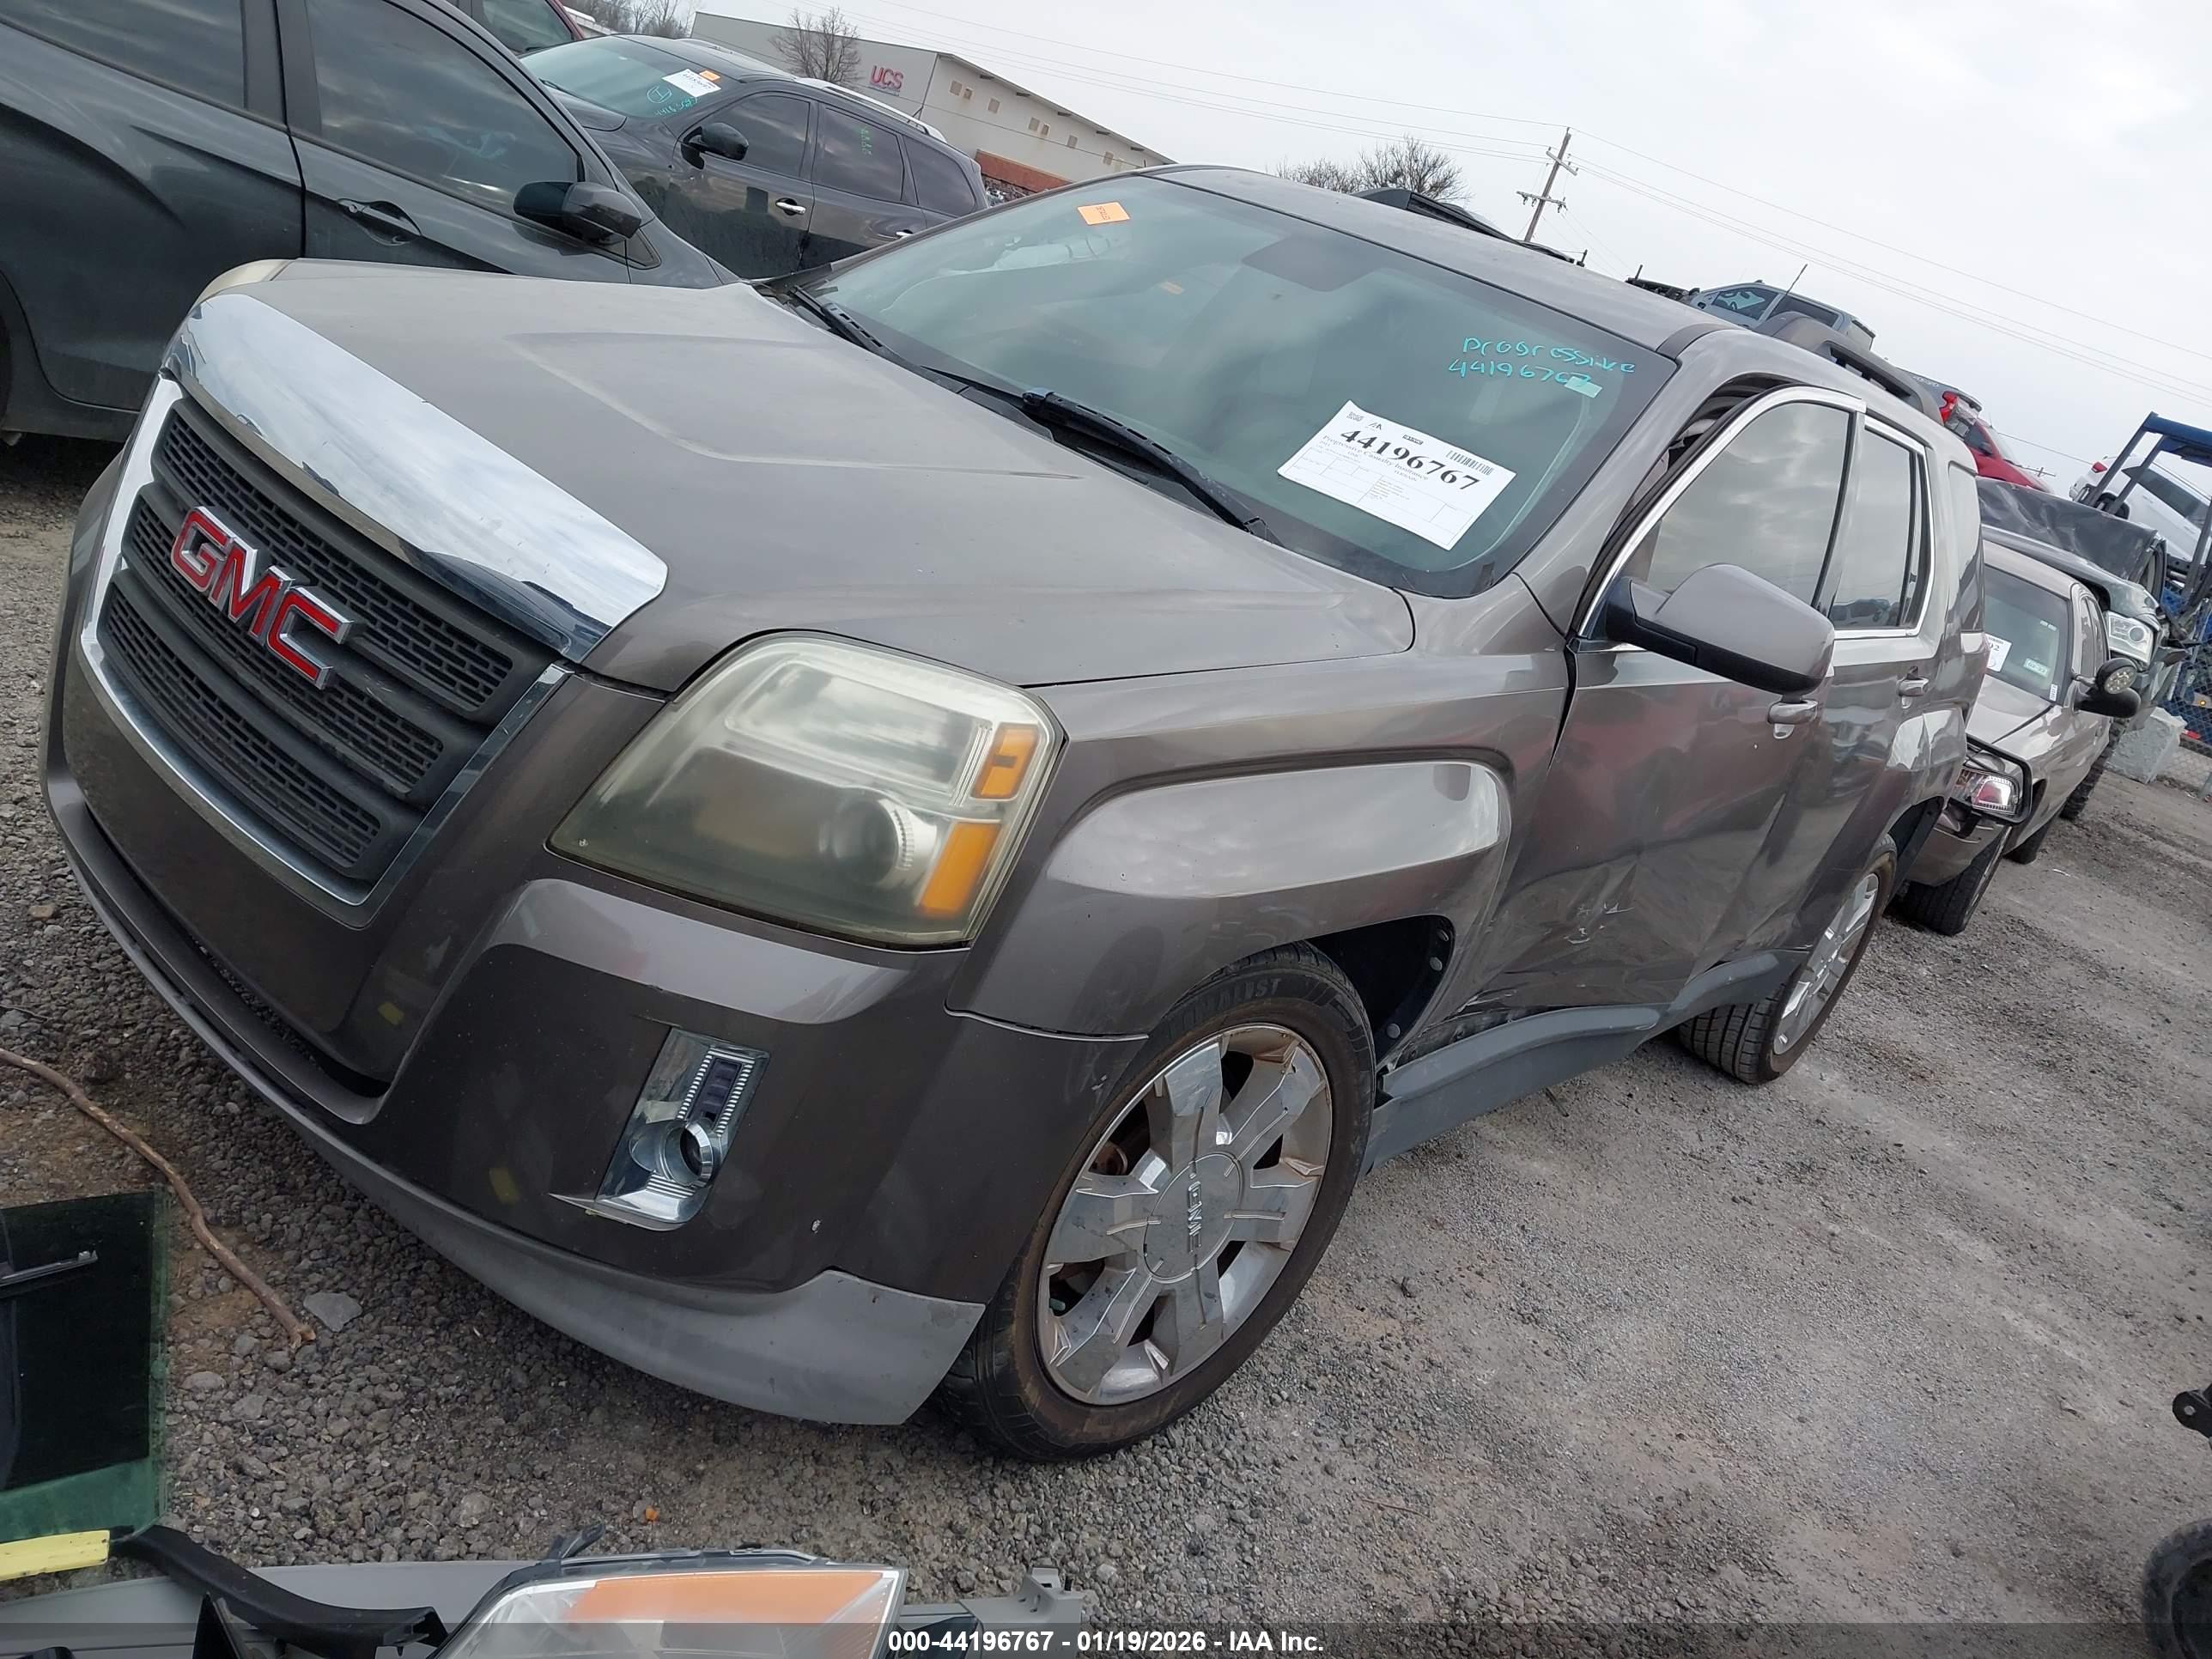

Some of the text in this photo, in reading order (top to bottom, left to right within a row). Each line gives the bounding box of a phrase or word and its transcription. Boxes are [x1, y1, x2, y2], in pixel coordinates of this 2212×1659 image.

[871, 64, 904, 89] UCS
[1340, 430, 1480, 489] 44196767
[171, 505, 354, 690] GMC
